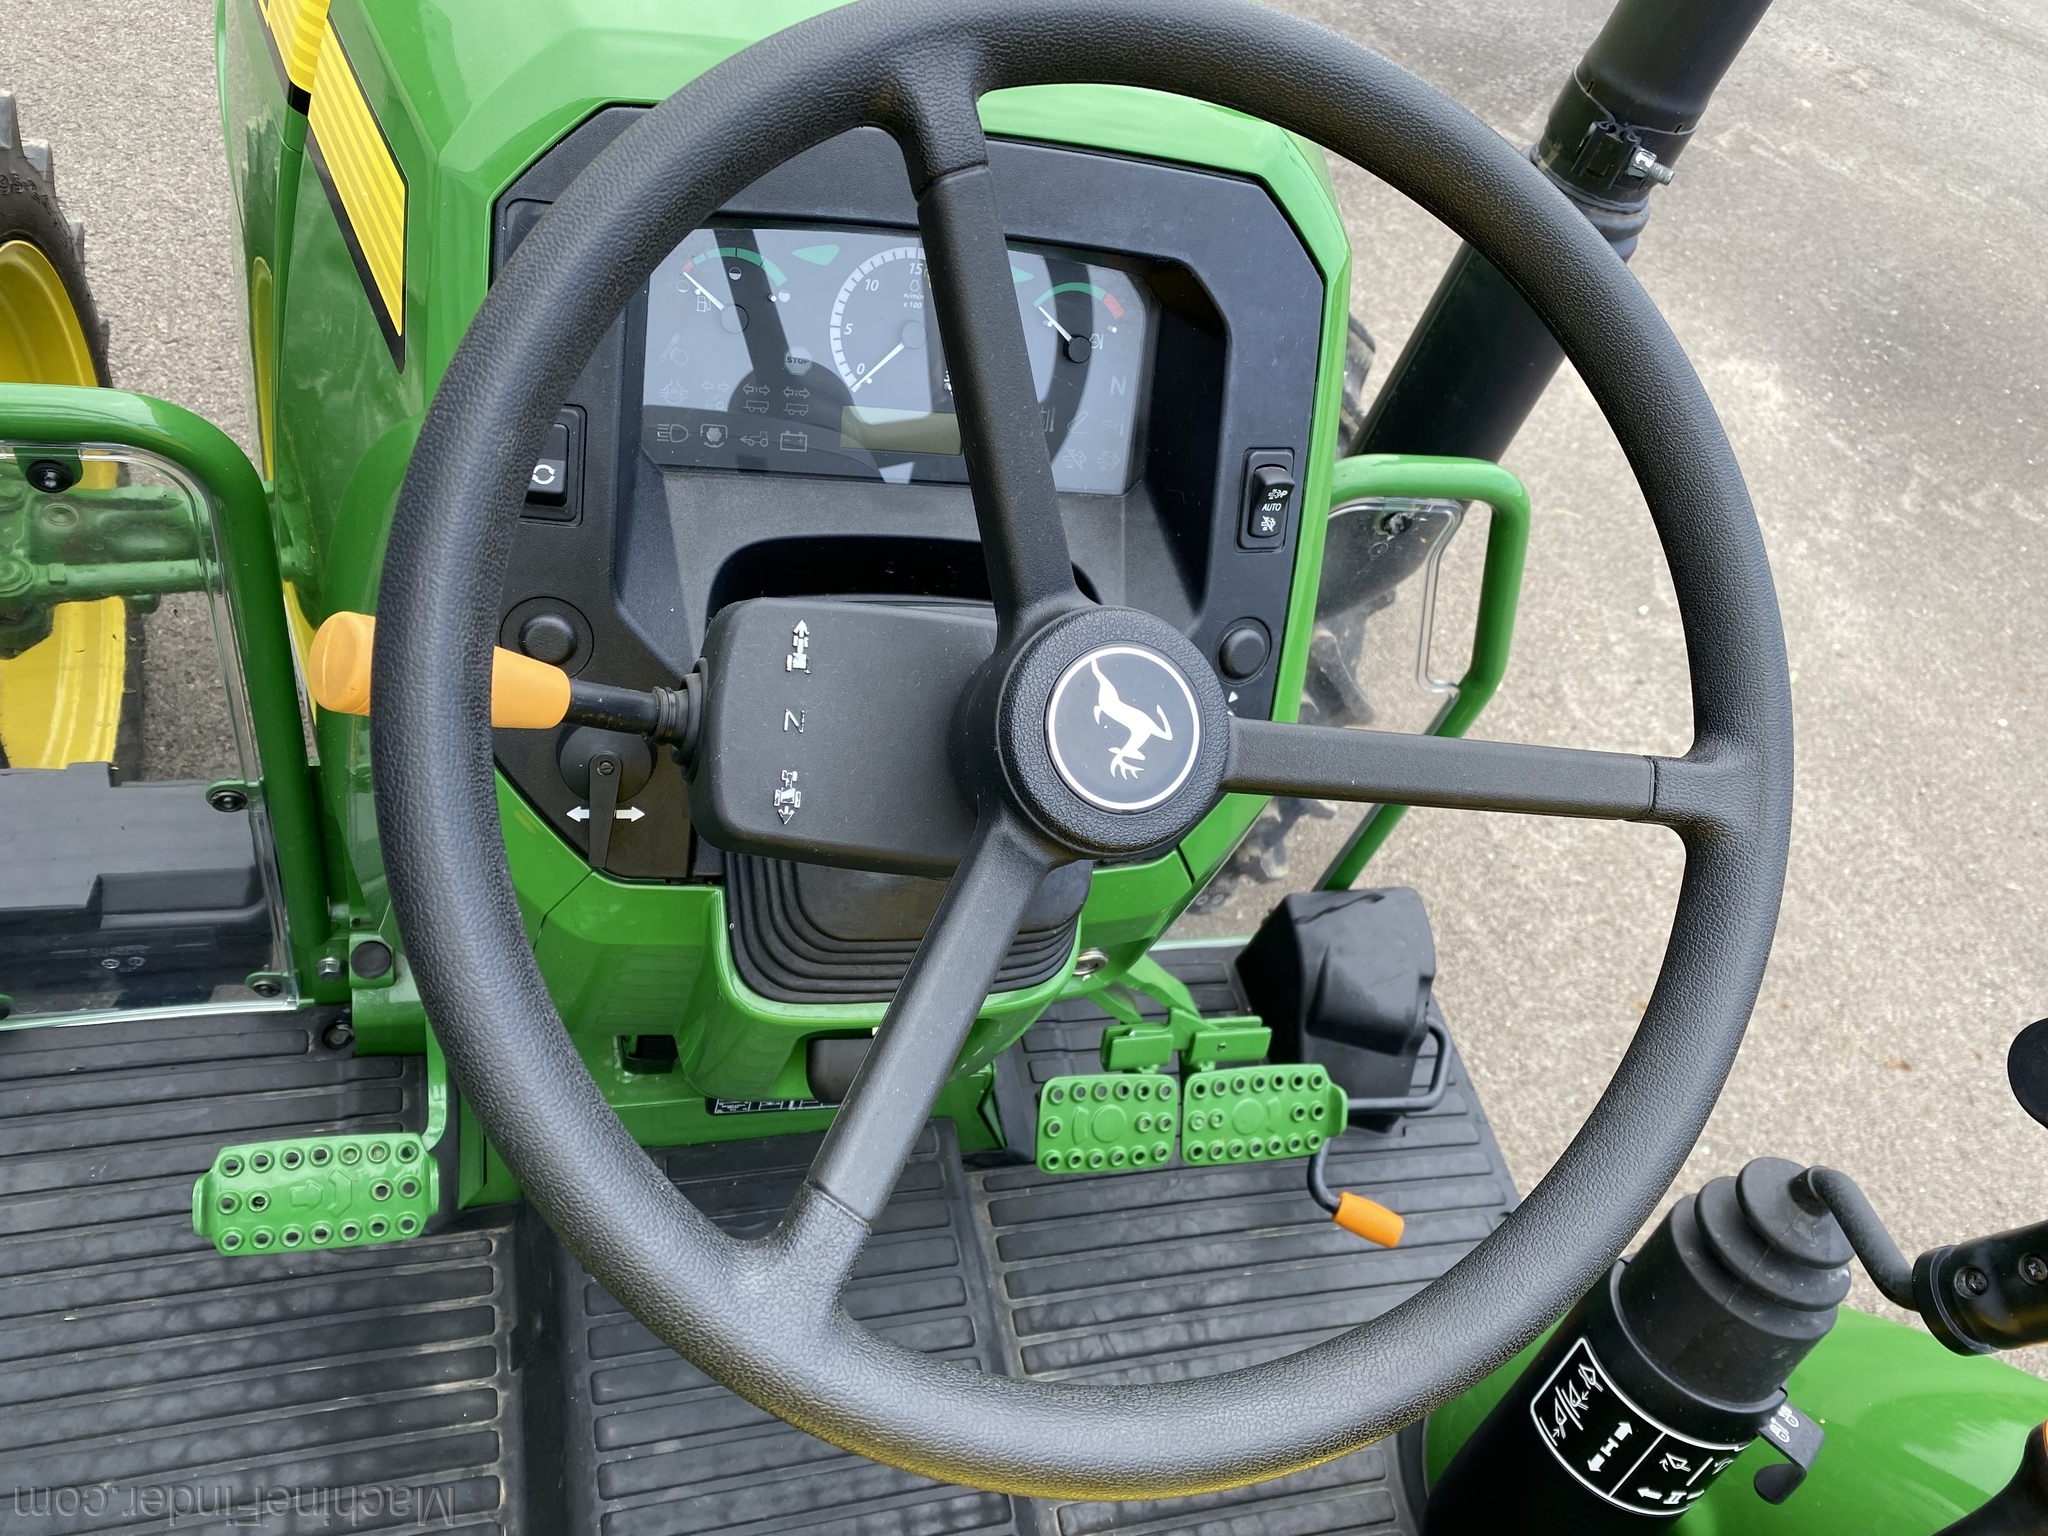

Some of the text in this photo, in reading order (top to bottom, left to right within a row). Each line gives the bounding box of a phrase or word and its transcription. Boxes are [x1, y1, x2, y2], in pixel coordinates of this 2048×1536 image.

[909, 262, 924, 275] 15
[865, 279, 880, 291] 10
[903, 292, 924, 300] n/min
[909, 301, 922, 309] 100
[843, 323, 853, 335] 5
[786, 356, 810, 365] STOP
[856, 363, 866, 375] 0
[1109, 376, 1127, 396] N
[1261, 503, 1282, 512] AUTO
[784, 708, 805, 733] N
